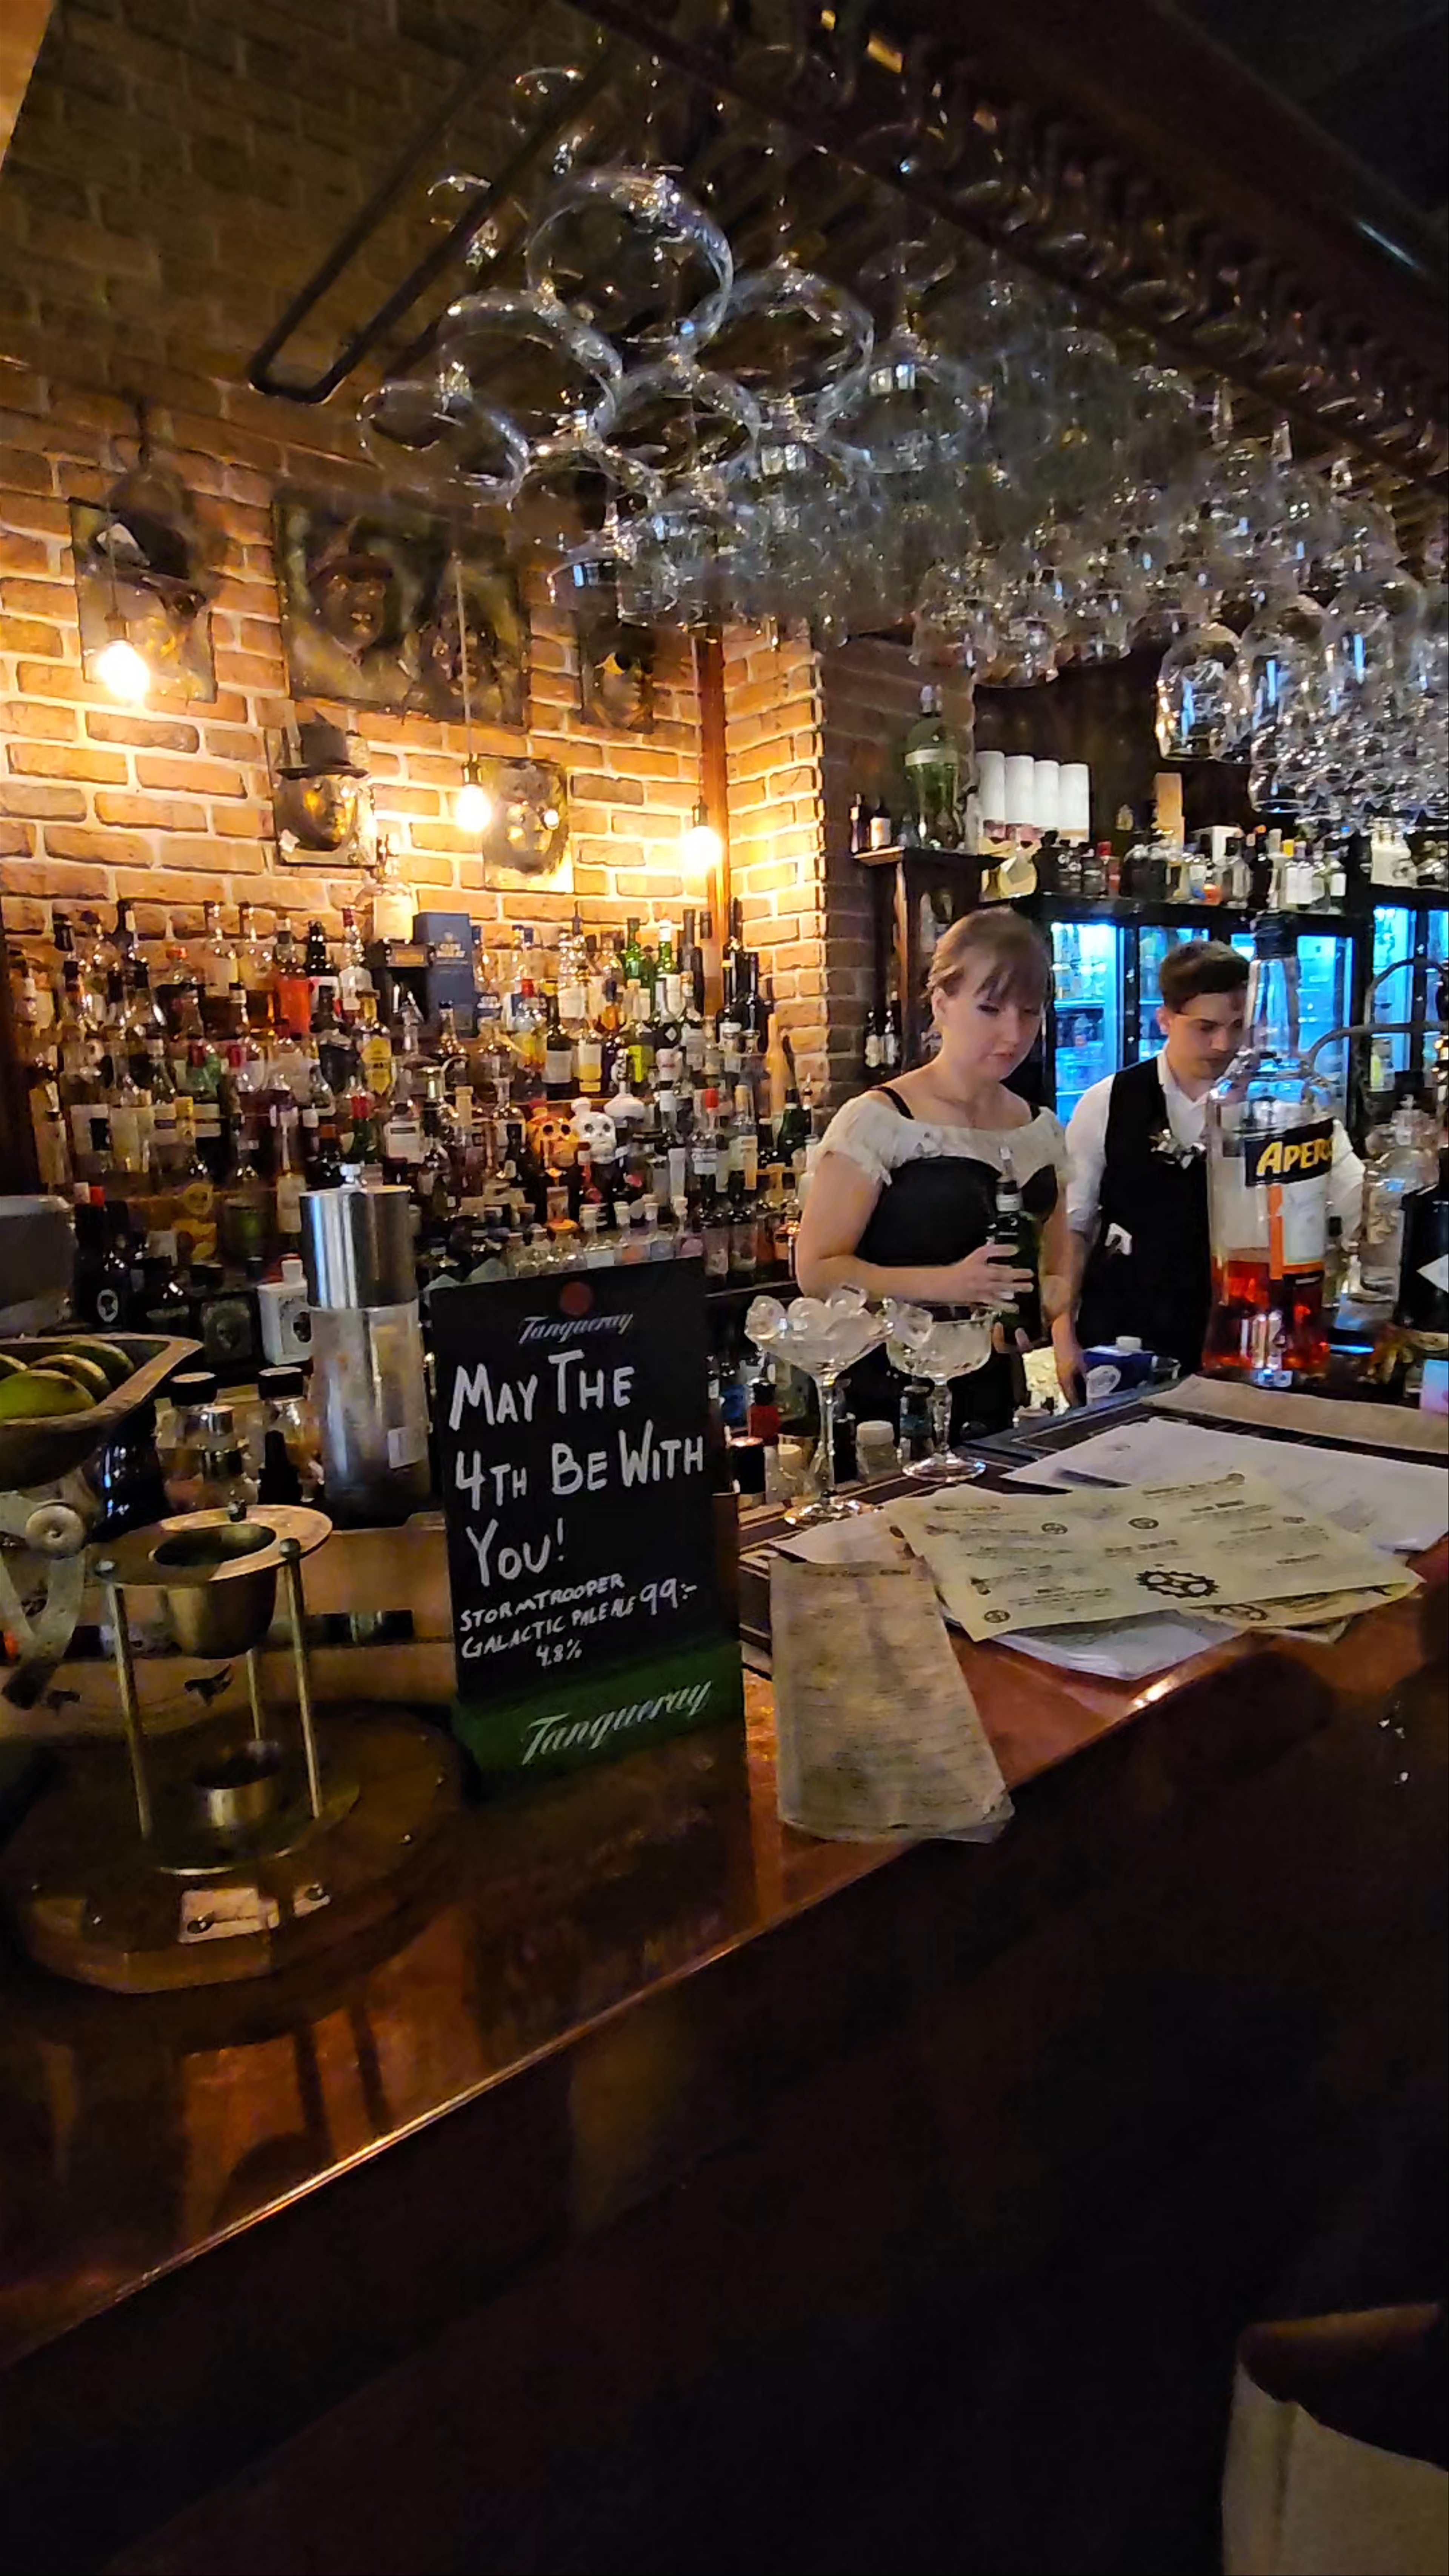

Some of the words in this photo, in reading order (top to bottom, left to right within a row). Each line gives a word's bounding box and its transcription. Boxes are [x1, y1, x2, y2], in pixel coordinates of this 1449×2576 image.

[518, 1313, 634, 1344] Tanqueray
[460, 1573, 625, 1632] STORMTROOPER
[461, 1615, 566, 1658] GALACTIC
[571, 1602, 608, 1627] PALE
[610, 1596, 636, 1618] ALE
[521, 1681, 711, 1765] Tanqueray
